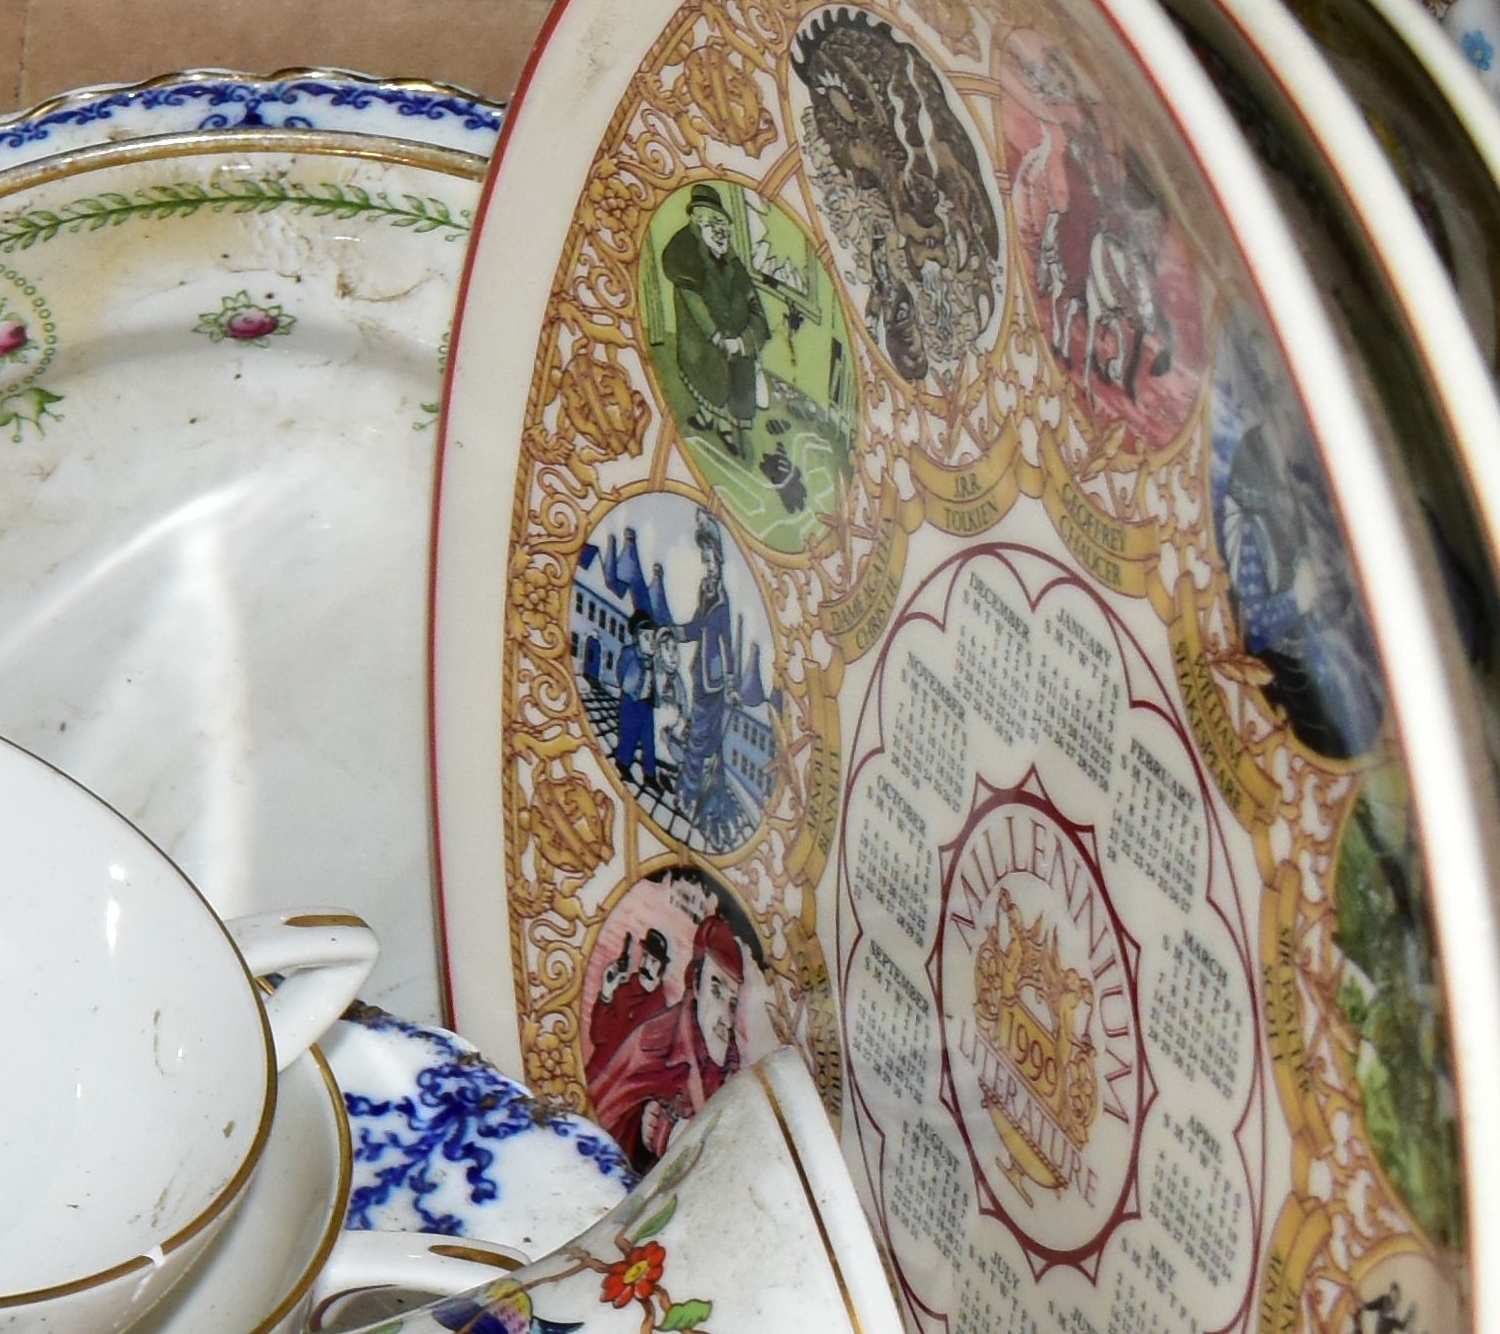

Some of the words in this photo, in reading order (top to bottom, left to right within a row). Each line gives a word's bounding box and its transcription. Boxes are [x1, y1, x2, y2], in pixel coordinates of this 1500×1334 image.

[944, 499, 999, 533] TOLKIEN
[1059, 514, 1123, 587] CHAUCER
[1062, 482, 1126, 553] GEOFFREY
[969, 571, 1030, 643] DECEMBER
[1057, 607, 1113, 668] JANUARY
[908, 650, 966, 724] NOVEMBER
[877, 774, 926, 837] OCTOBER
[1130, 736, 1196, 812] FEBRUARY
[870, 939, 929, 1017] SEPTEMBER
[950, 816, 1133, 1125] MILLENNIUM
[1183, 929, 1229, 989] MARCH
[1006, 1012, 1058, 1097] 1999
[917, 1117, 960, 1174] AUGUST
[958, 1018, 1100, 1209] LITERATURE
[1187, 1114, 1223, 1164] APRIL
[991, 1251, 1020, 1291] JULY
[1150, 1243, 1176, 1283] MAY
